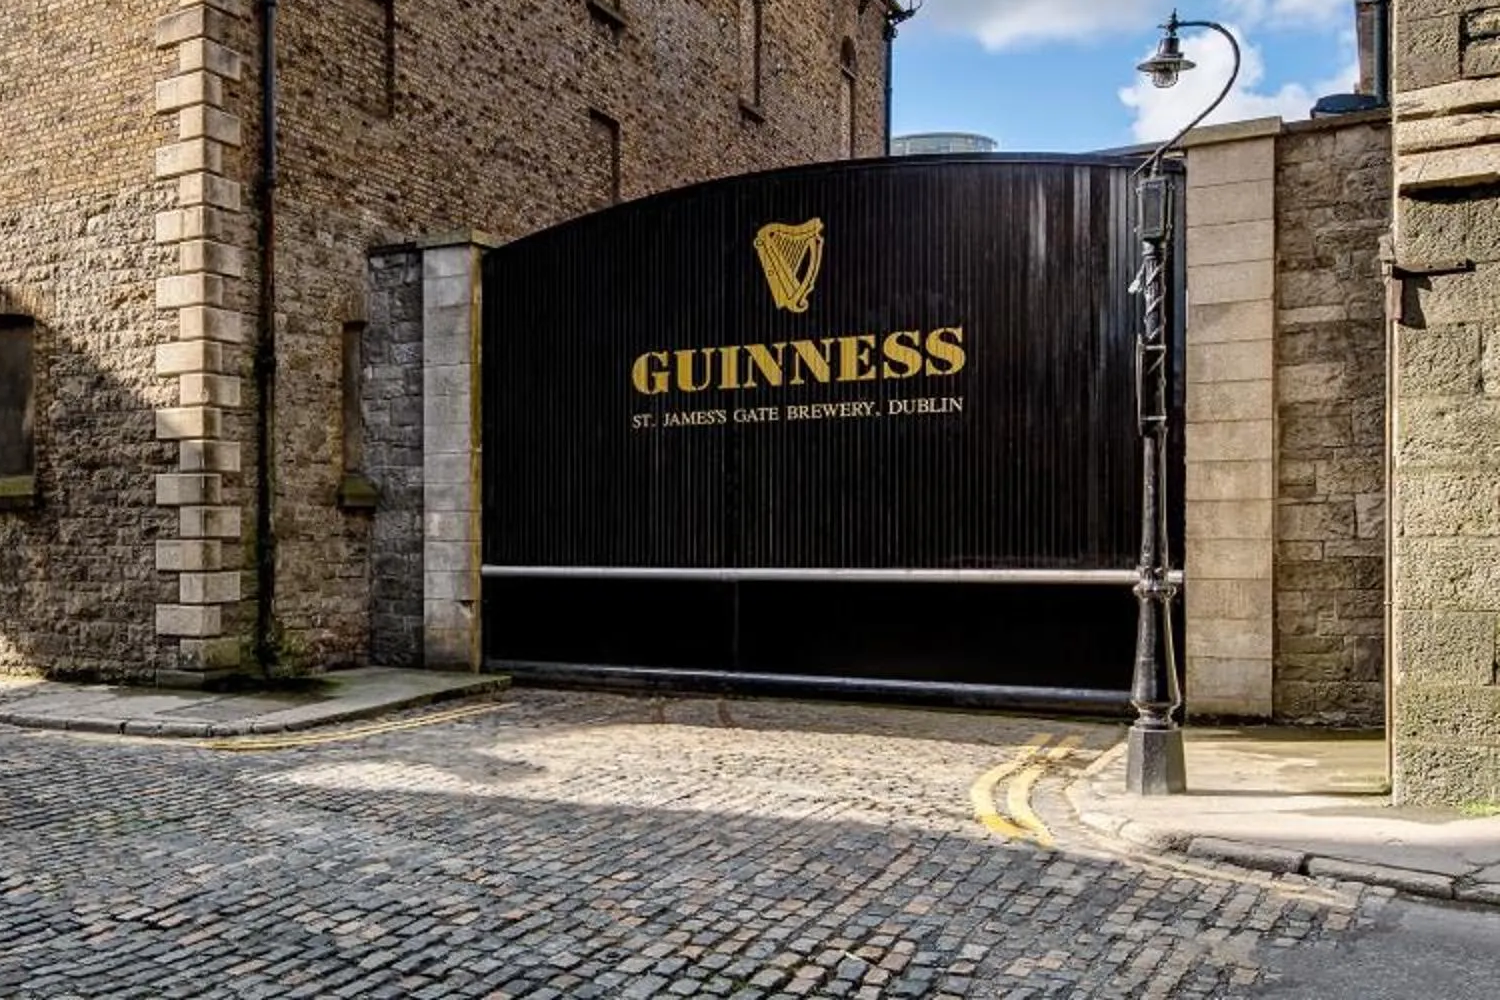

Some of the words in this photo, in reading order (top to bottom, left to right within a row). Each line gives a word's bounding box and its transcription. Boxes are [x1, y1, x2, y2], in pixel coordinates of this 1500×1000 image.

[632, 326, 967, 395] GUINNESS
[632, 413, 656, 429] ST.
[733, 407, 780, 423] GATE
[888, 396, 964, 415] DUBLIN
